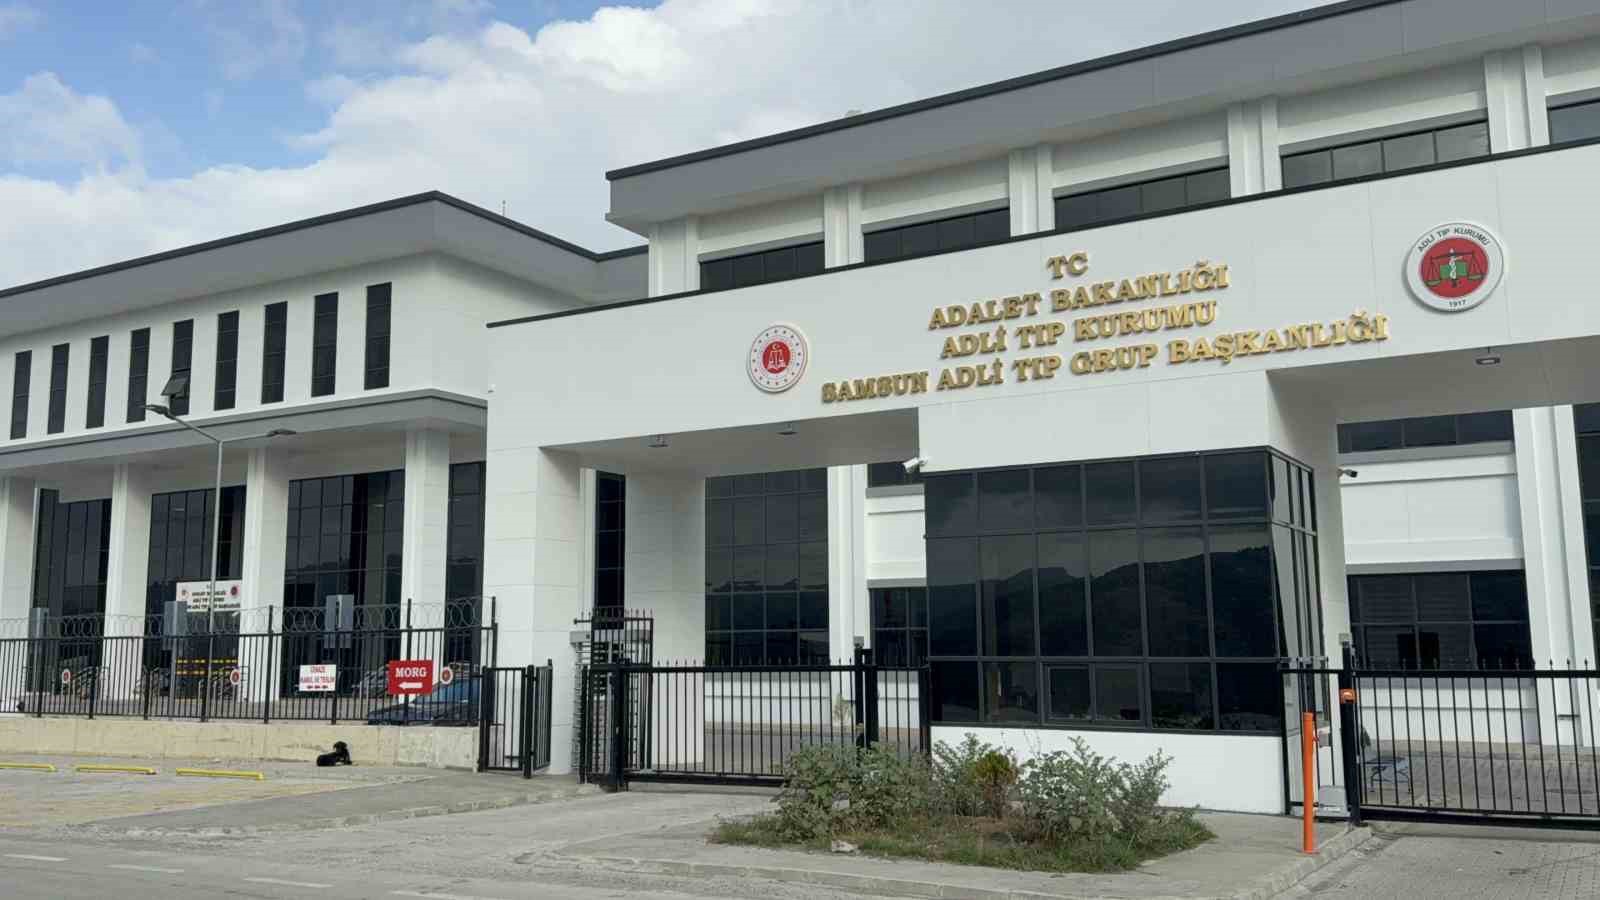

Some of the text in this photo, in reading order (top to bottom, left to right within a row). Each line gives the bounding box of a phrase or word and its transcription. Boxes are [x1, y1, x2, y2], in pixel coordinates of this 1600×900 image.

[1454, 227, 1490, 246] KURUMU
[1047, 252, 1088, 280] TC
[928, 259, 1230, 330] ADALET BAKANLIĞI
[941, 299, 1217, 360] ADLİ TIP KURUMU
[821, 309, 1388, 403] SAMSUN ADLİ TIP GRUP BAŞKANLIĞI
[395, 667, 427, 678] MORG
